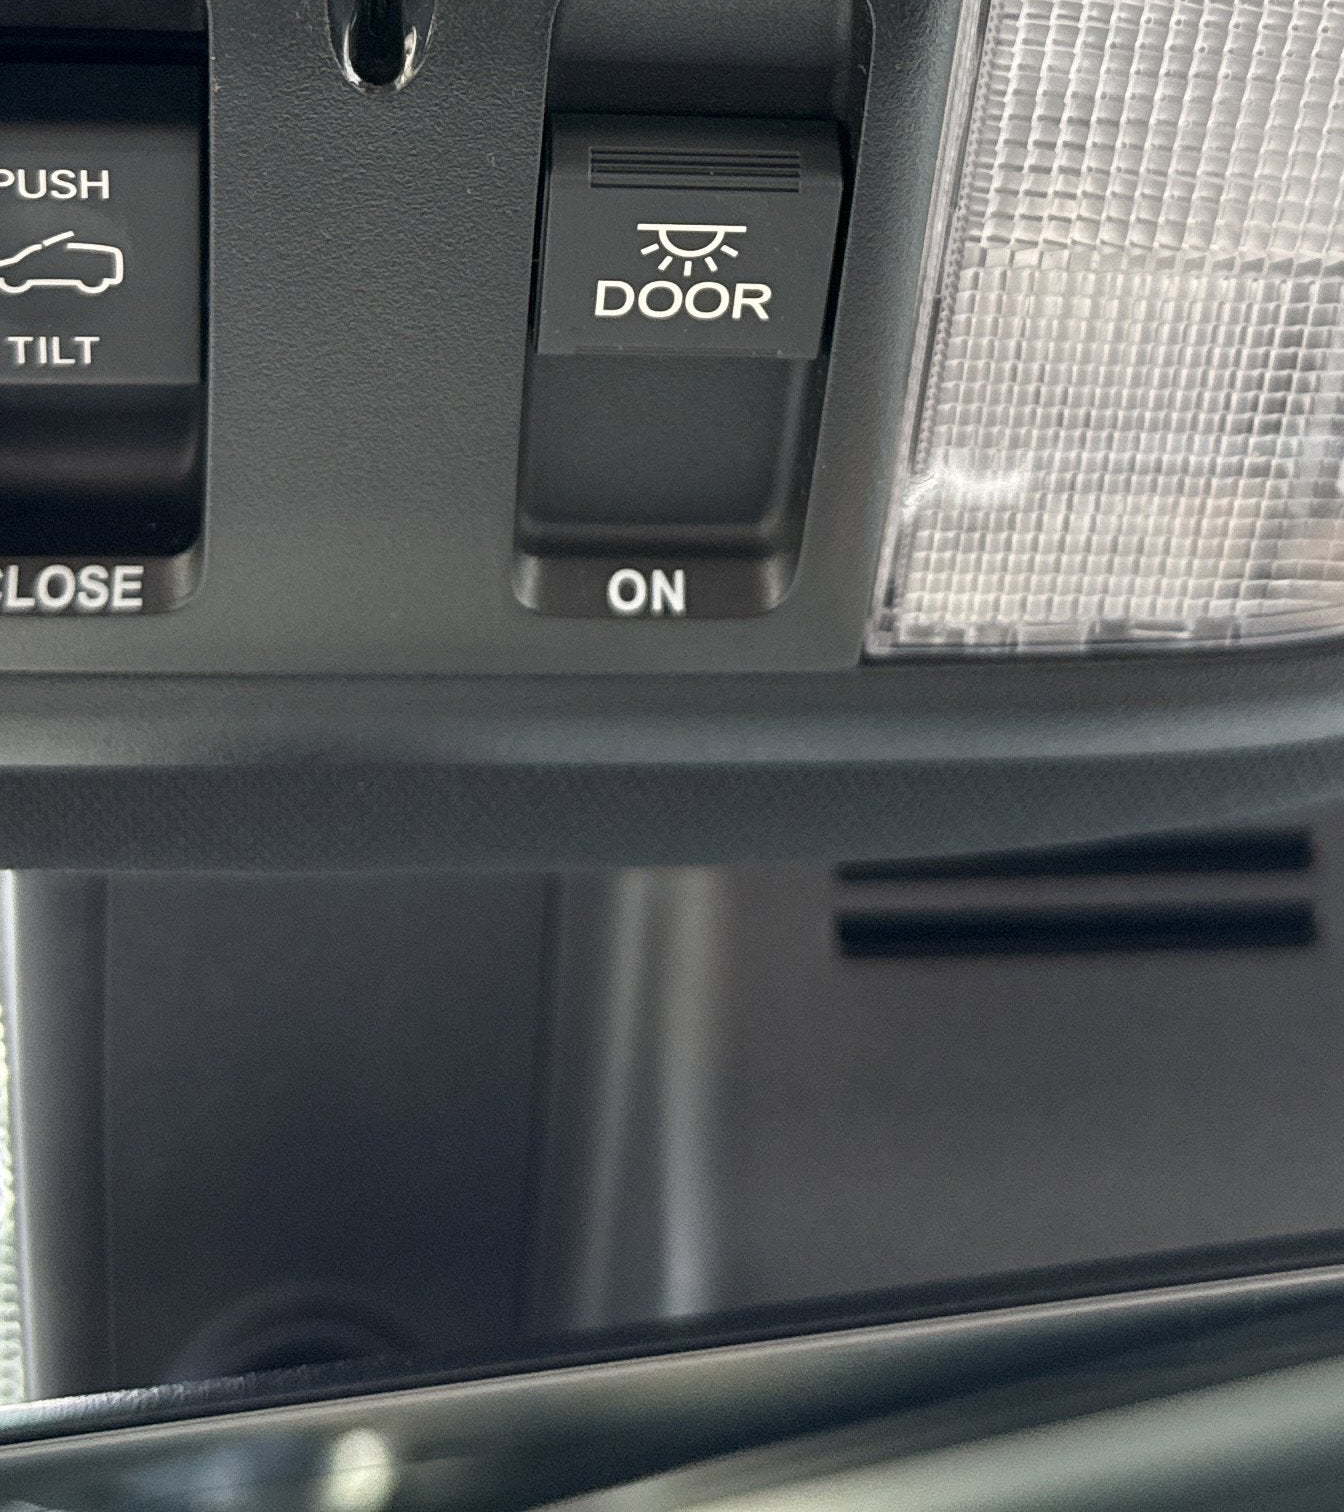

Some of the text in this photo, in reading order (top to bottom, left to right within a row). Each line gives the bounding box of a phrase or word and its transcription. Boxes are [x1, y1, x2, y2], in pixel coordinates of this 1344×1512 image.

[593, 279, 773, 321] DOOR
[6, 335, 101, 366] TILT
[607, 567, 686, 614] ON
